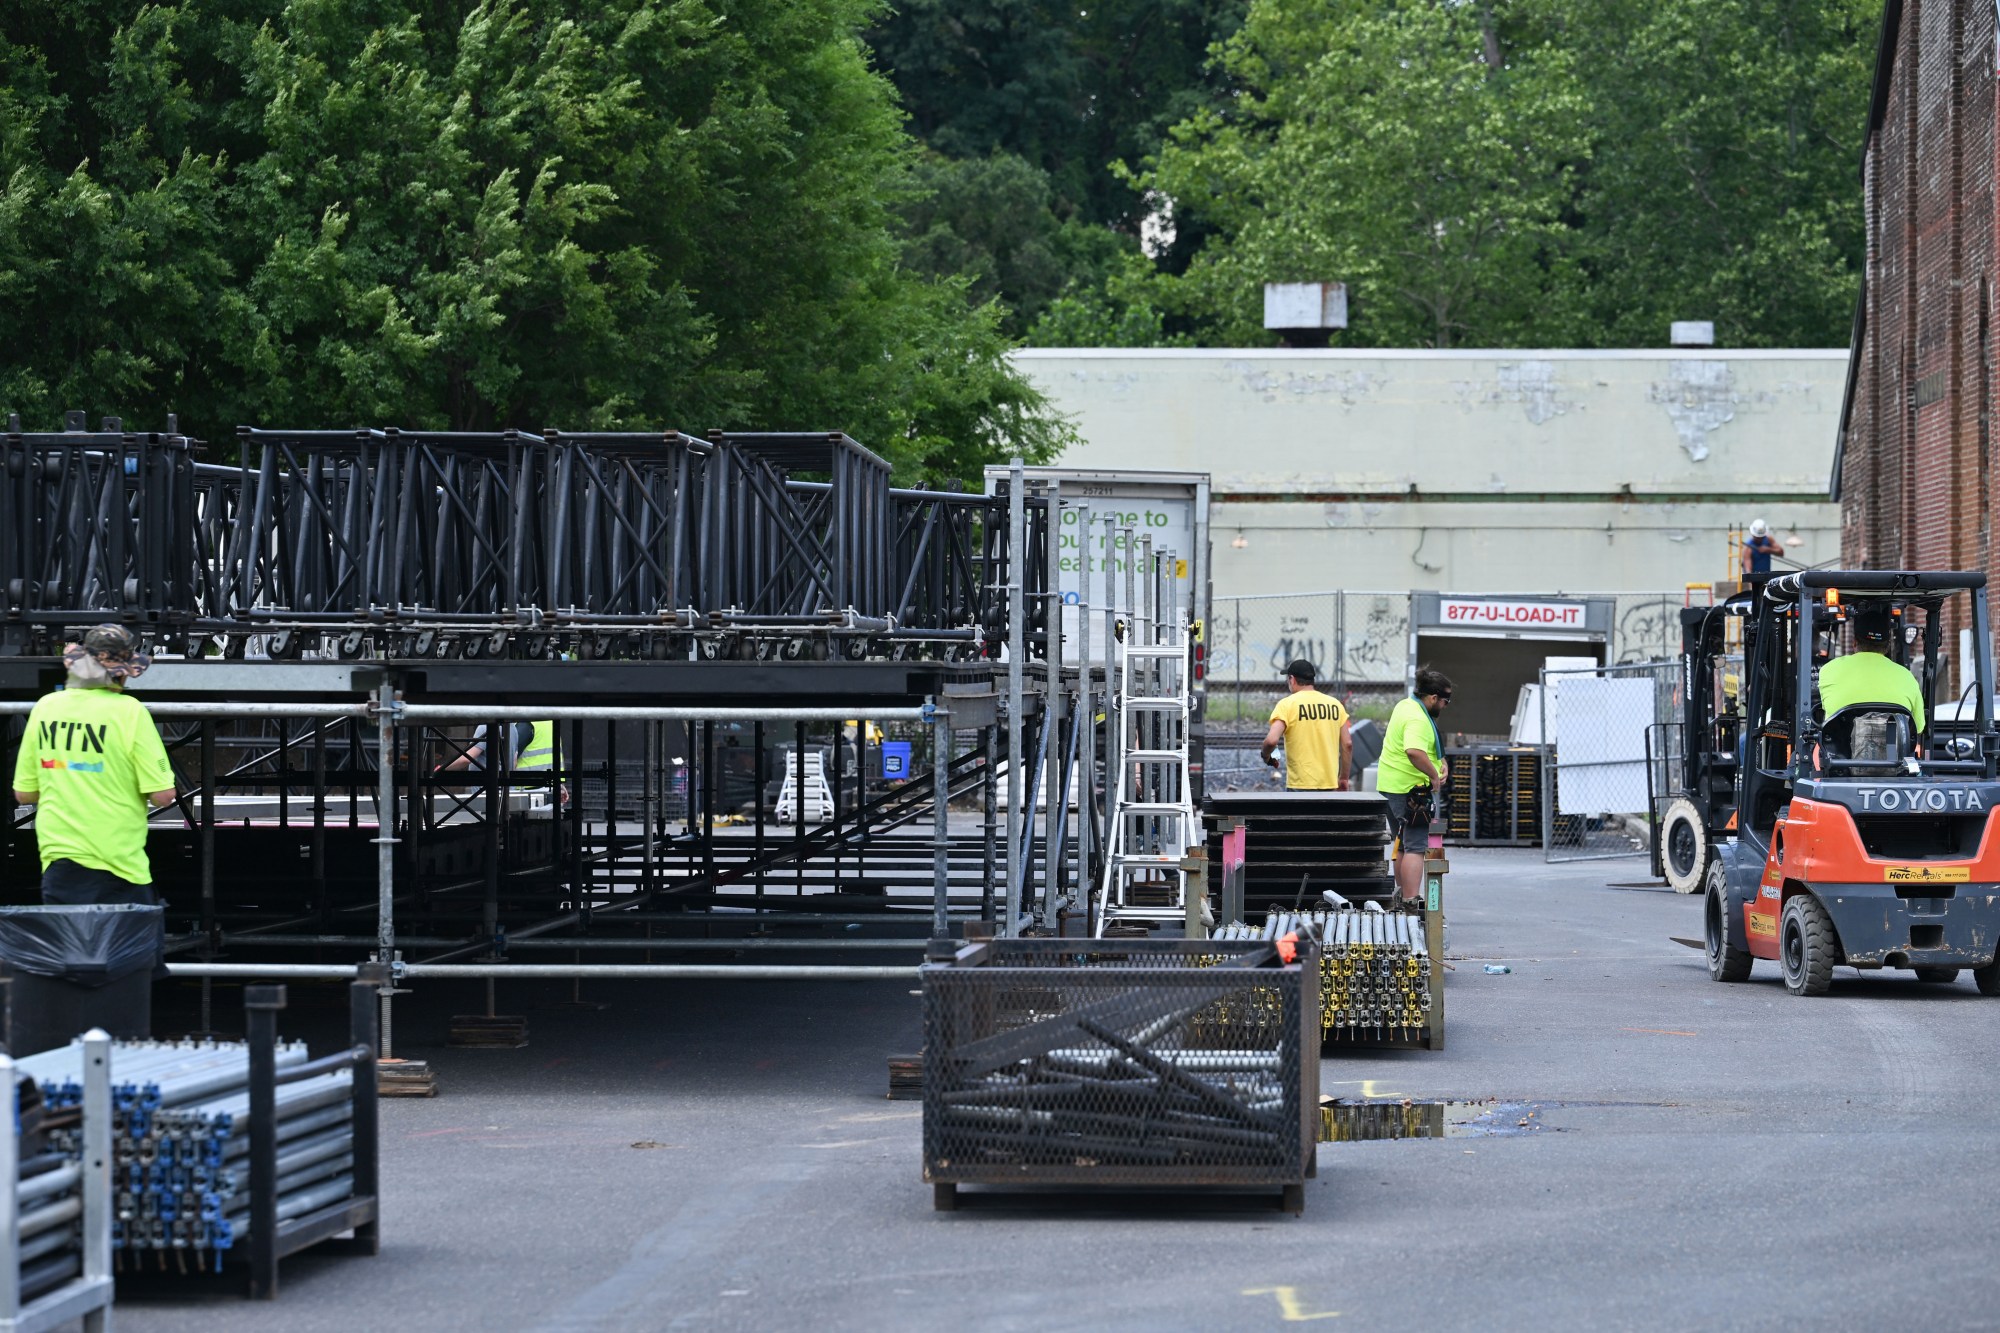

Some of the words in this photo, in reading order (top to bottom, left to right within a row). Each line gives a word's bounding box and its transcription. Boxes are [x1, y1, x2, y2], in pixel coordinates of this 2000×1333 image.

[1083, 487, 1112, 496] 257211
[1145, 509, 1169, 527] to
[1447, 604, 1579, 623] 877-U-LOAD-IT
[1298, 703, 1340, 721] AUDIO
[39, 720, 107, 754] MTN
[1857, 788, 1983, 811] TOYOTA
